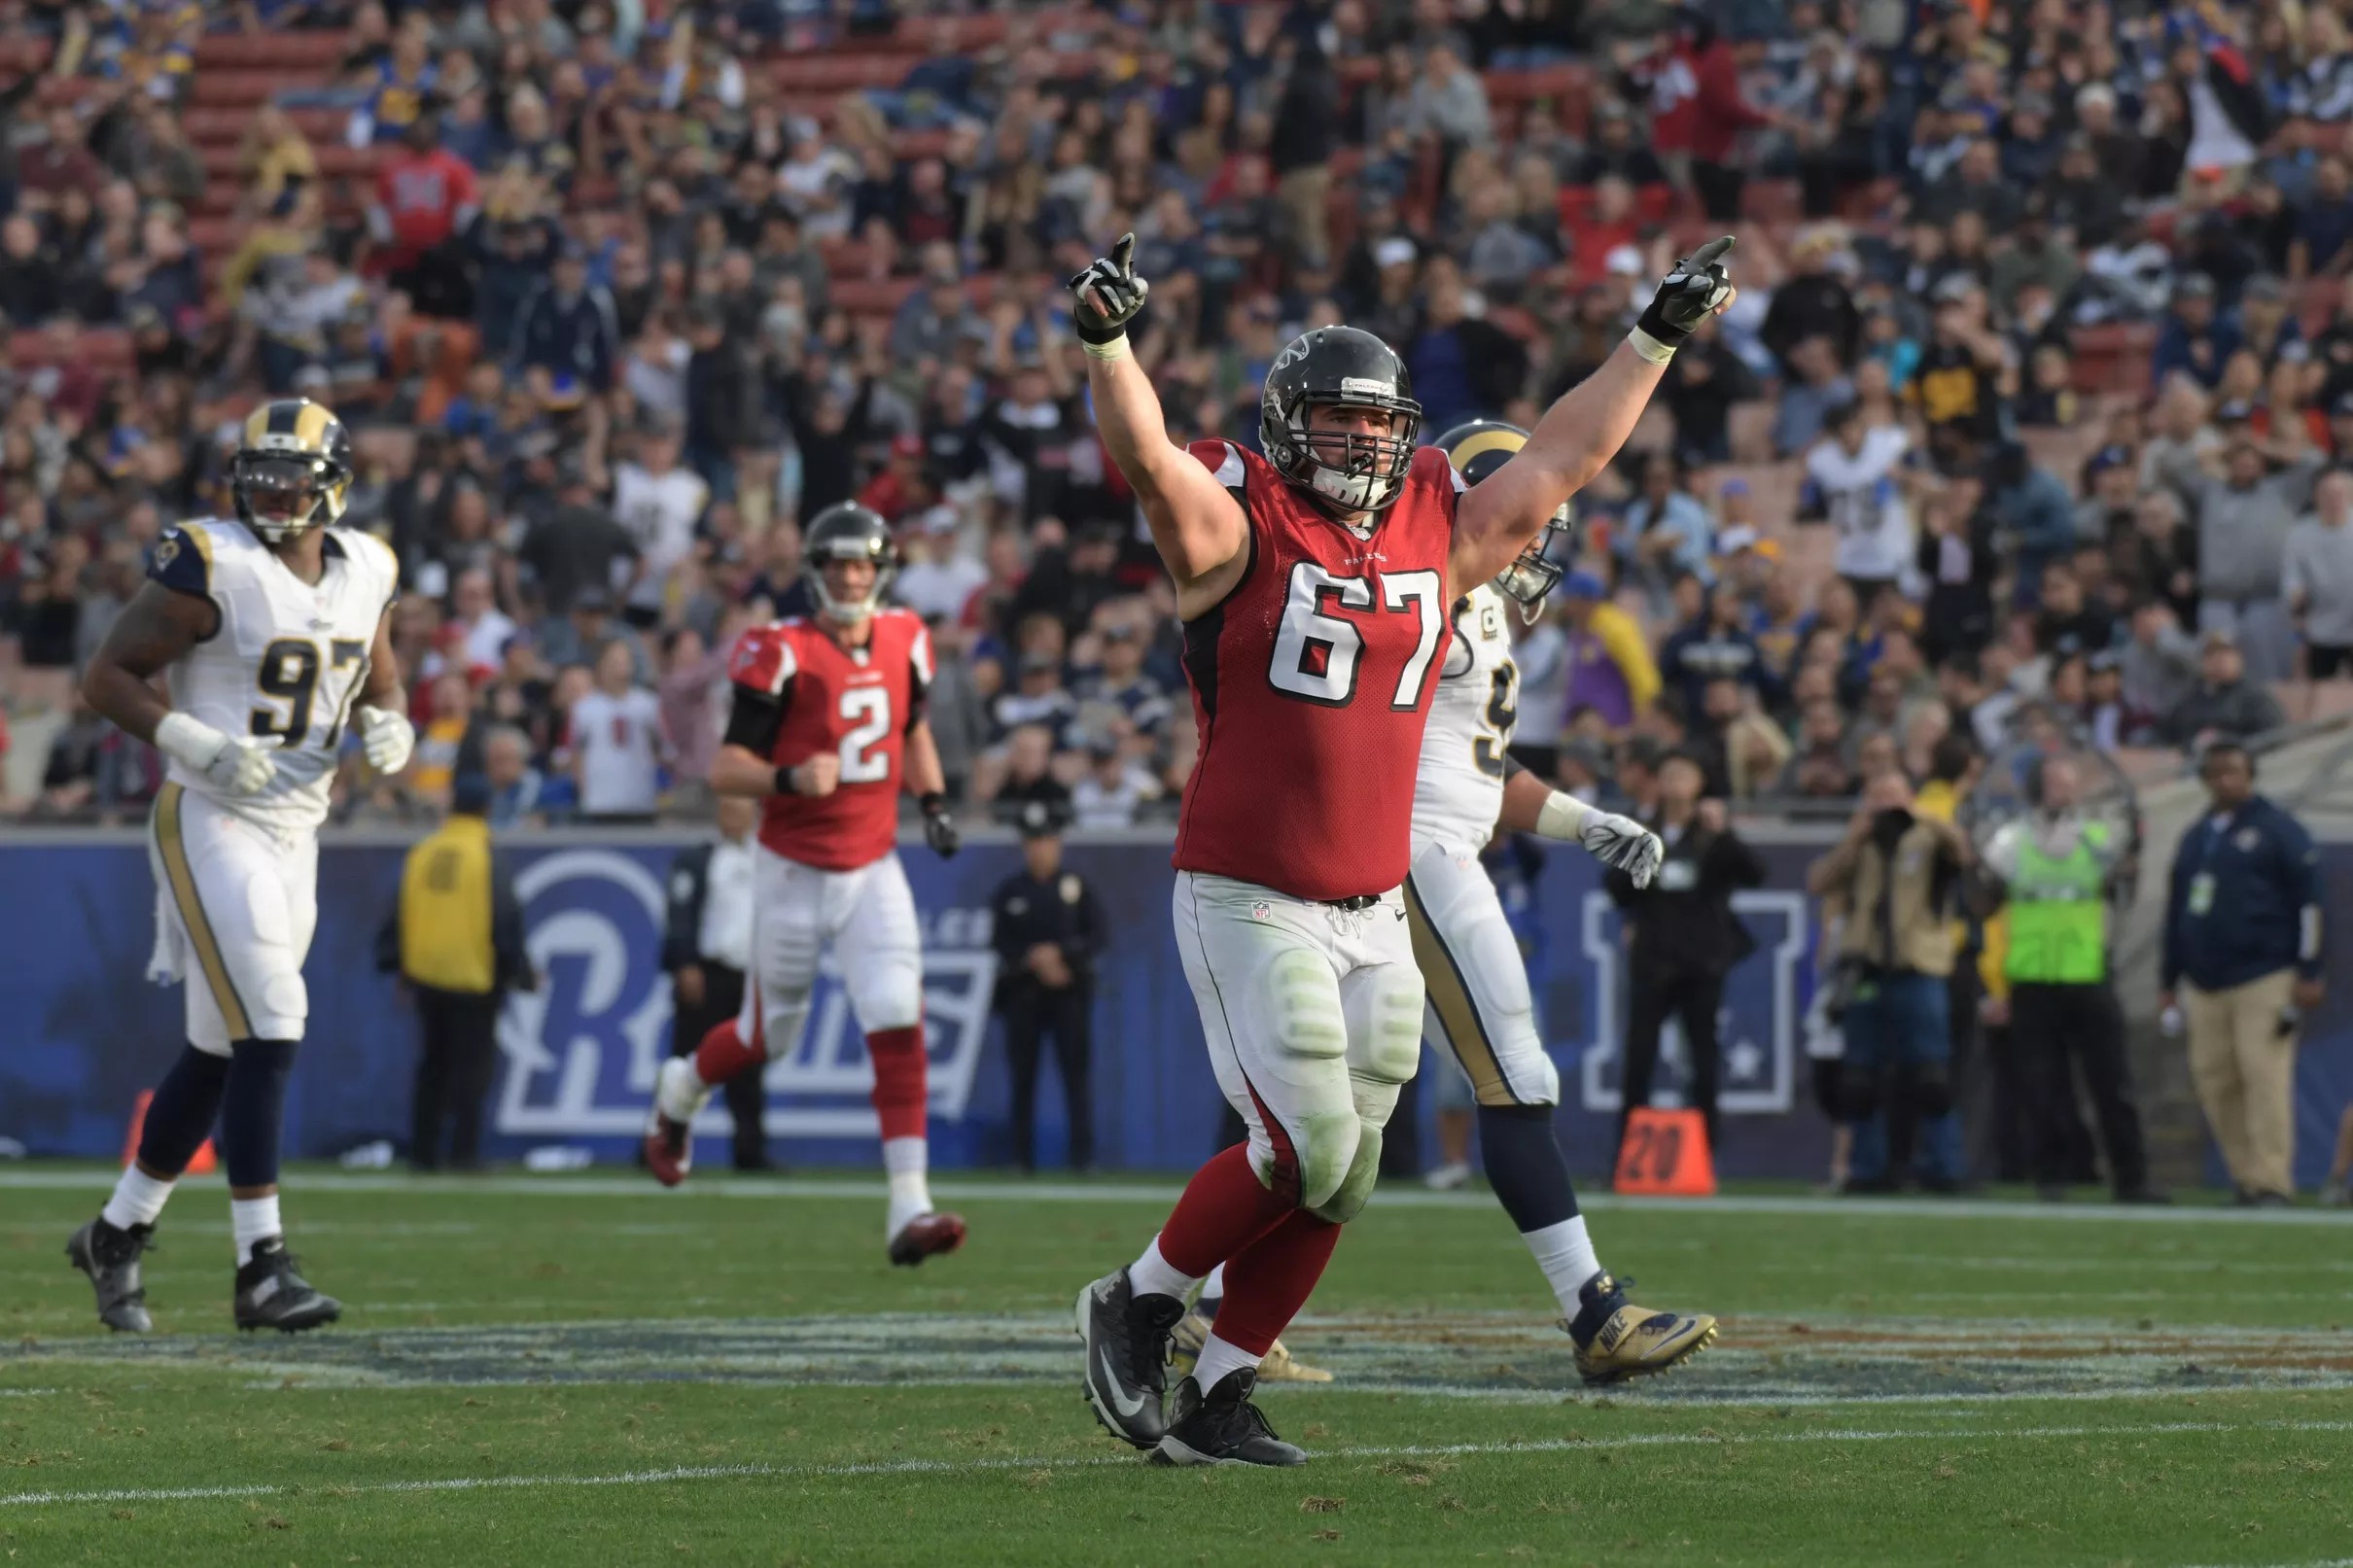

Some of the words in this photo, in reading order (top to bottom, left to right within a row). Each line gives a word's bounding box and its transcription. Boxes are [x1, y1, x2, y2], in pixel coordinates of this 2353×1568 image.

[1269, 561, 1446, 713] 67
[249, 637, 371, 750] 97
[839, 685, 891, 784] 2
[1626, 1124, 1683, 1183] 20
[1598, 1311, 1628, 1353] NIKE
